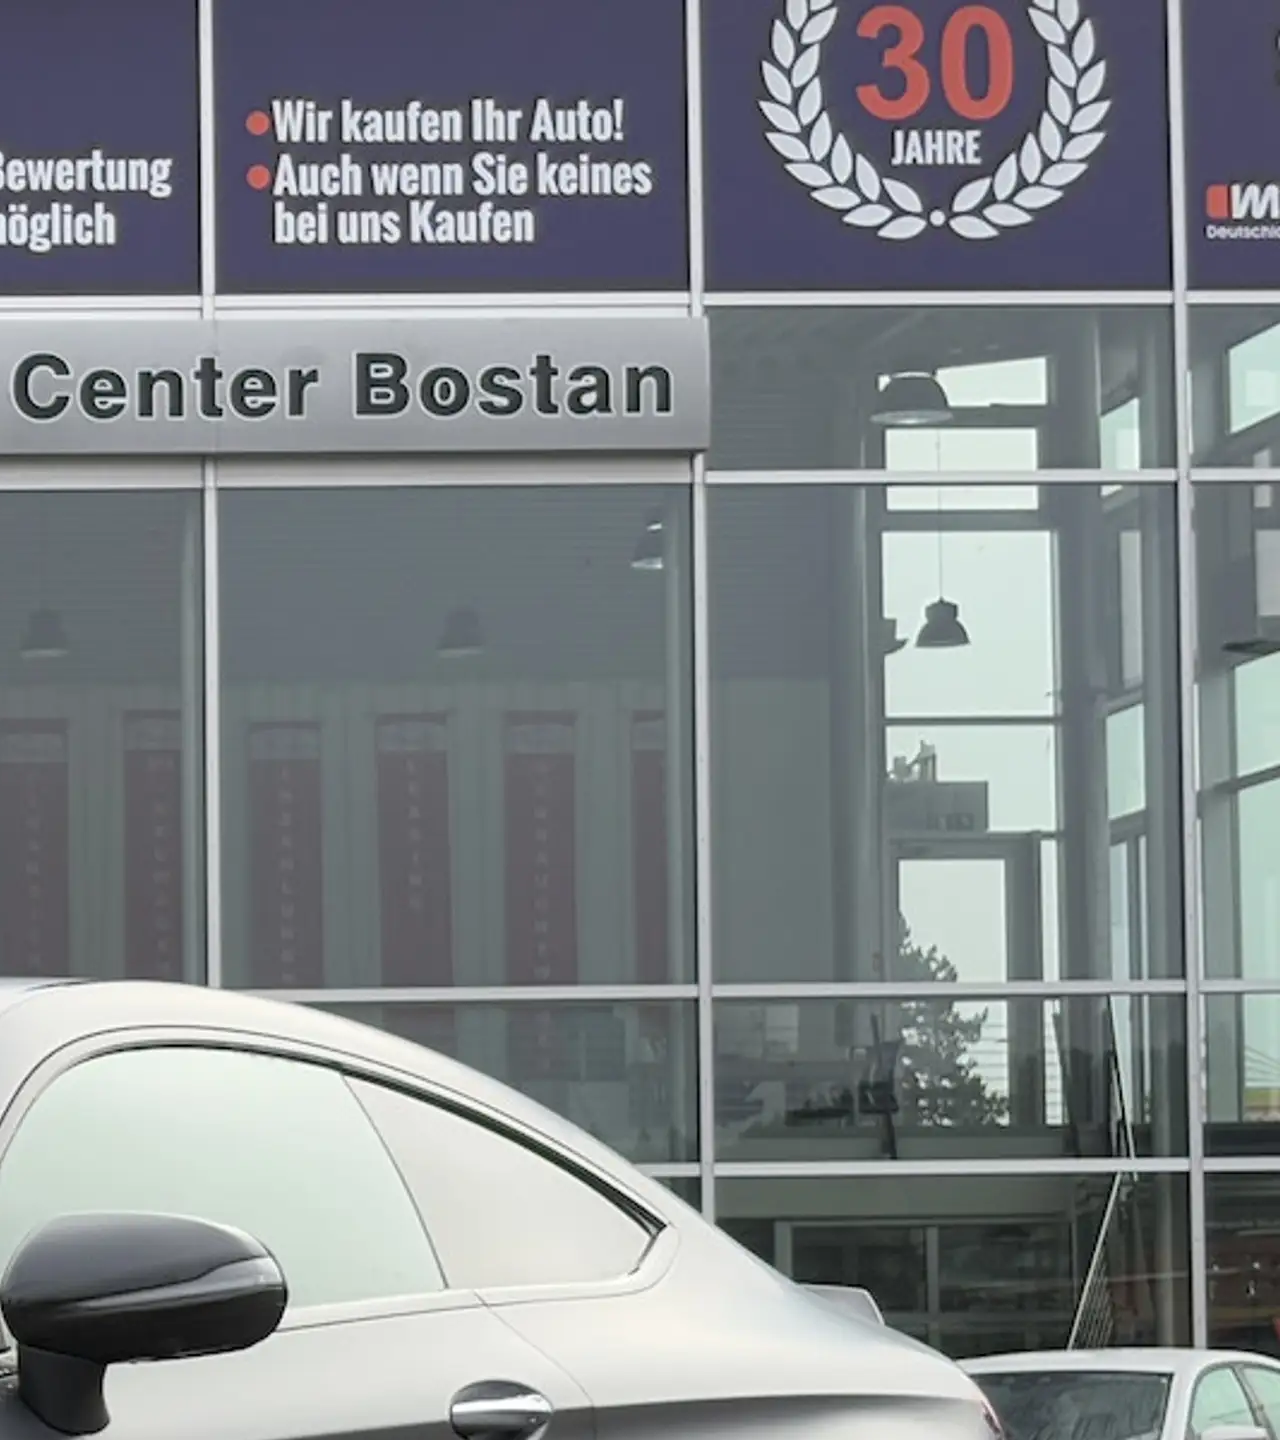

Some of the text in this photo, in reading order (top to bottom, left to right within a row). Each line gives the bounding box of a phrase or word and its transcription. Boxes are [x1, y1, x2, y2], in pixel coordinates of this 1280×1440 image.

[856, 6, 1013, 120] 30
[273, 98, 623, 143] Wir kaufen Ihr Auto!
[892, 130, 981, 166] JAHRE
[274, 152, 652, 196] Auch wenn Sie keines
[275, 200, 534, 243] bei uns Kaufen
[13, 355, 319, 420] Center
[357, 353, 672, 417] Bostan
